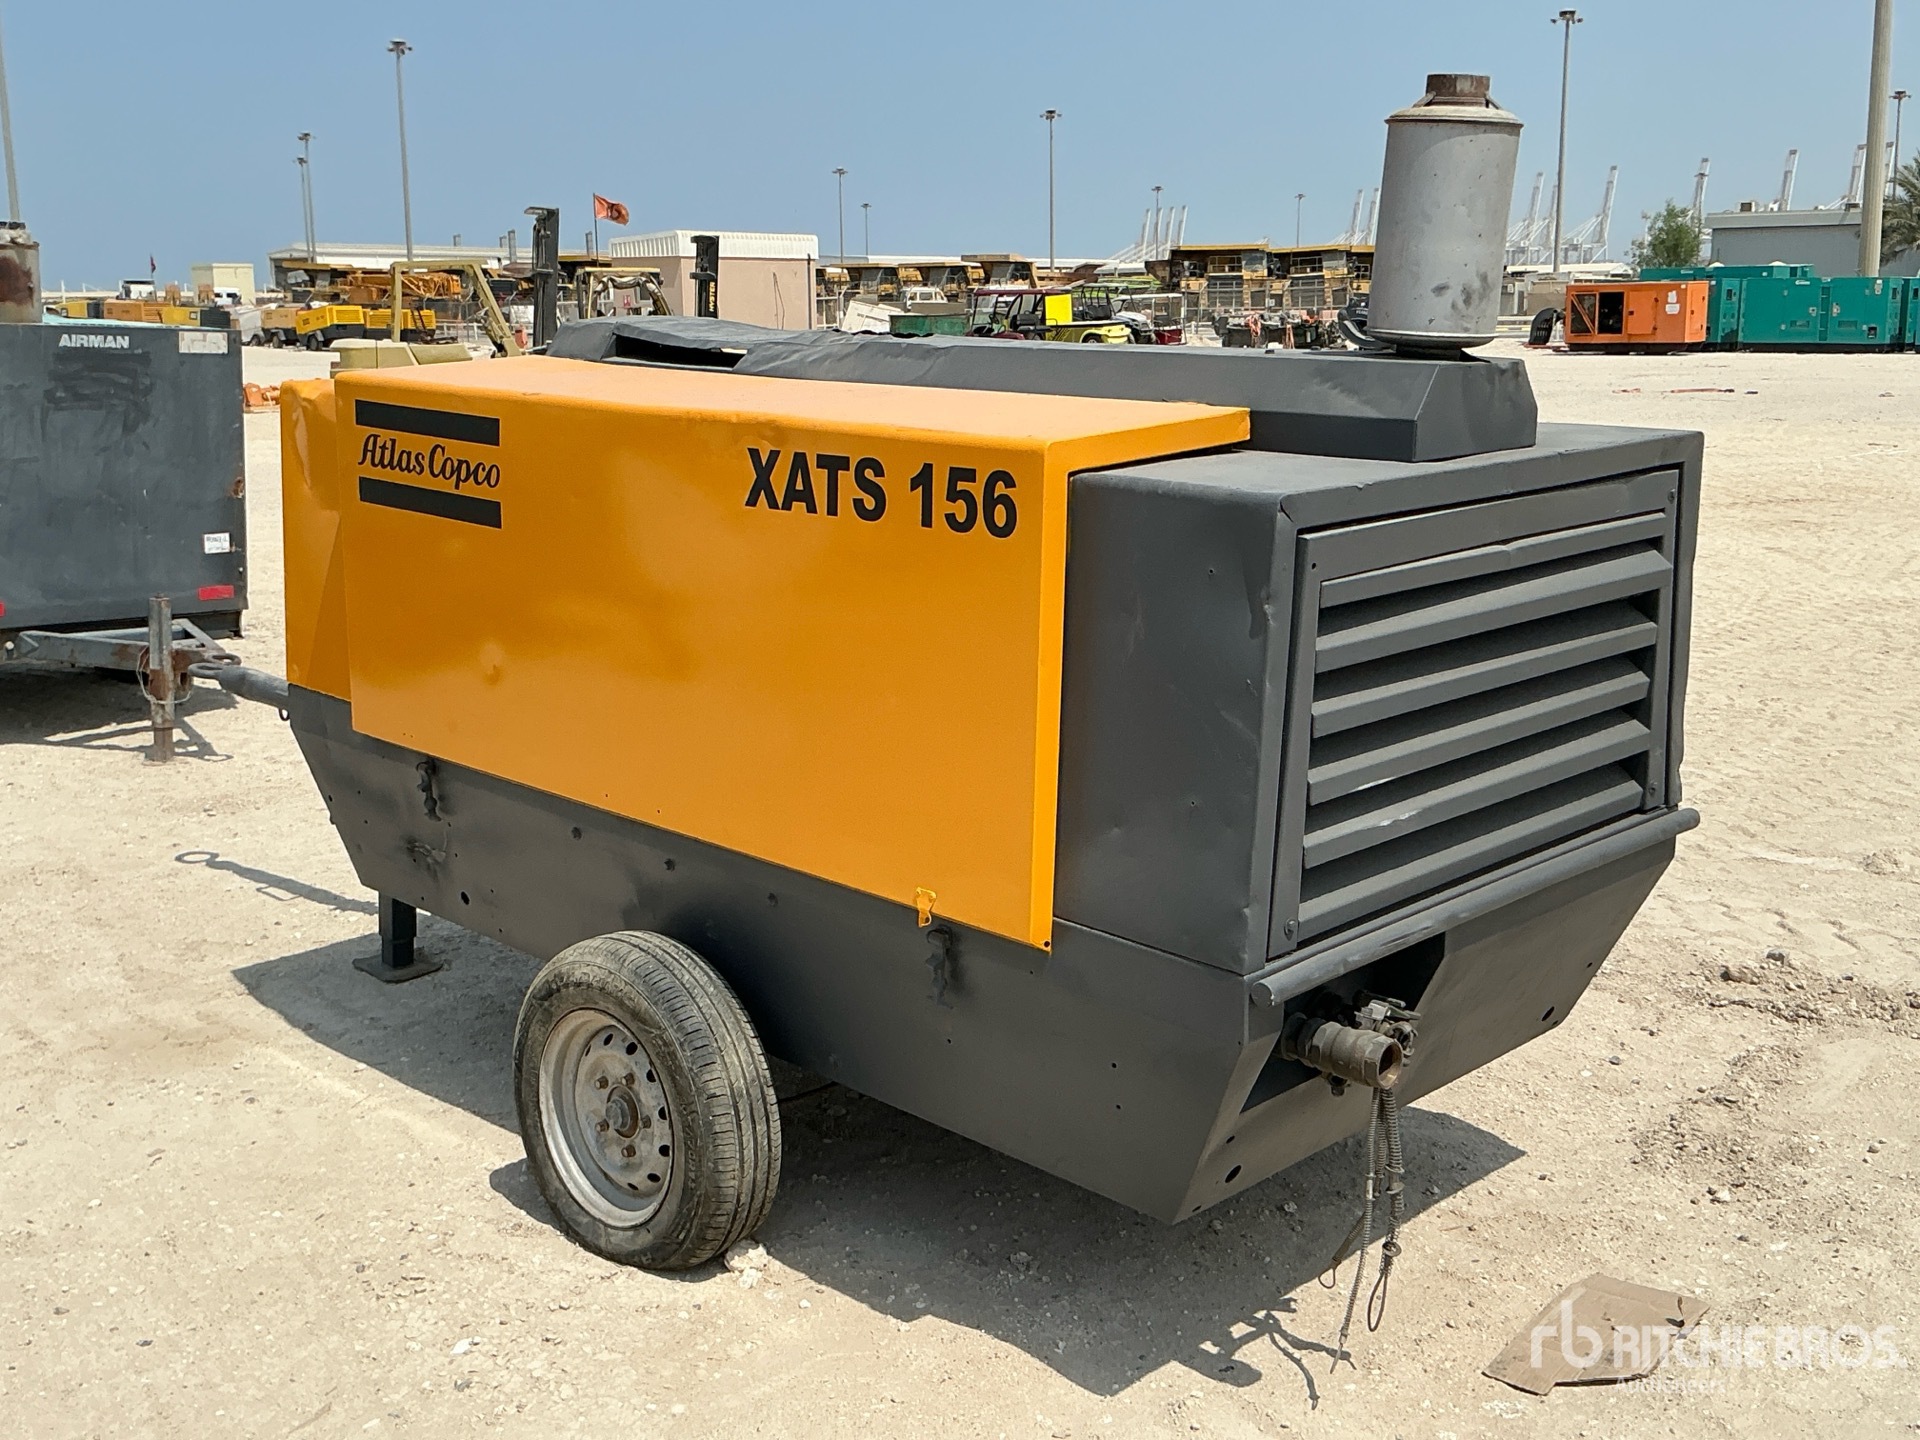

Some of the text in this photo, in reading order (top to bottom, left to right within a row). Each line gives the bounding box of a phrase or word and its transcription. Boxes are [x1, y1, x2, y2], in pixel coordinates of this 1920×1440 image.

[708, 281, 716, 312] HYSTER
[58, 333, 130, 349] AIRMAN
[357, 433, 501, 490] Atlas Copco
[745, 447, 1018, 539] XATS 156
